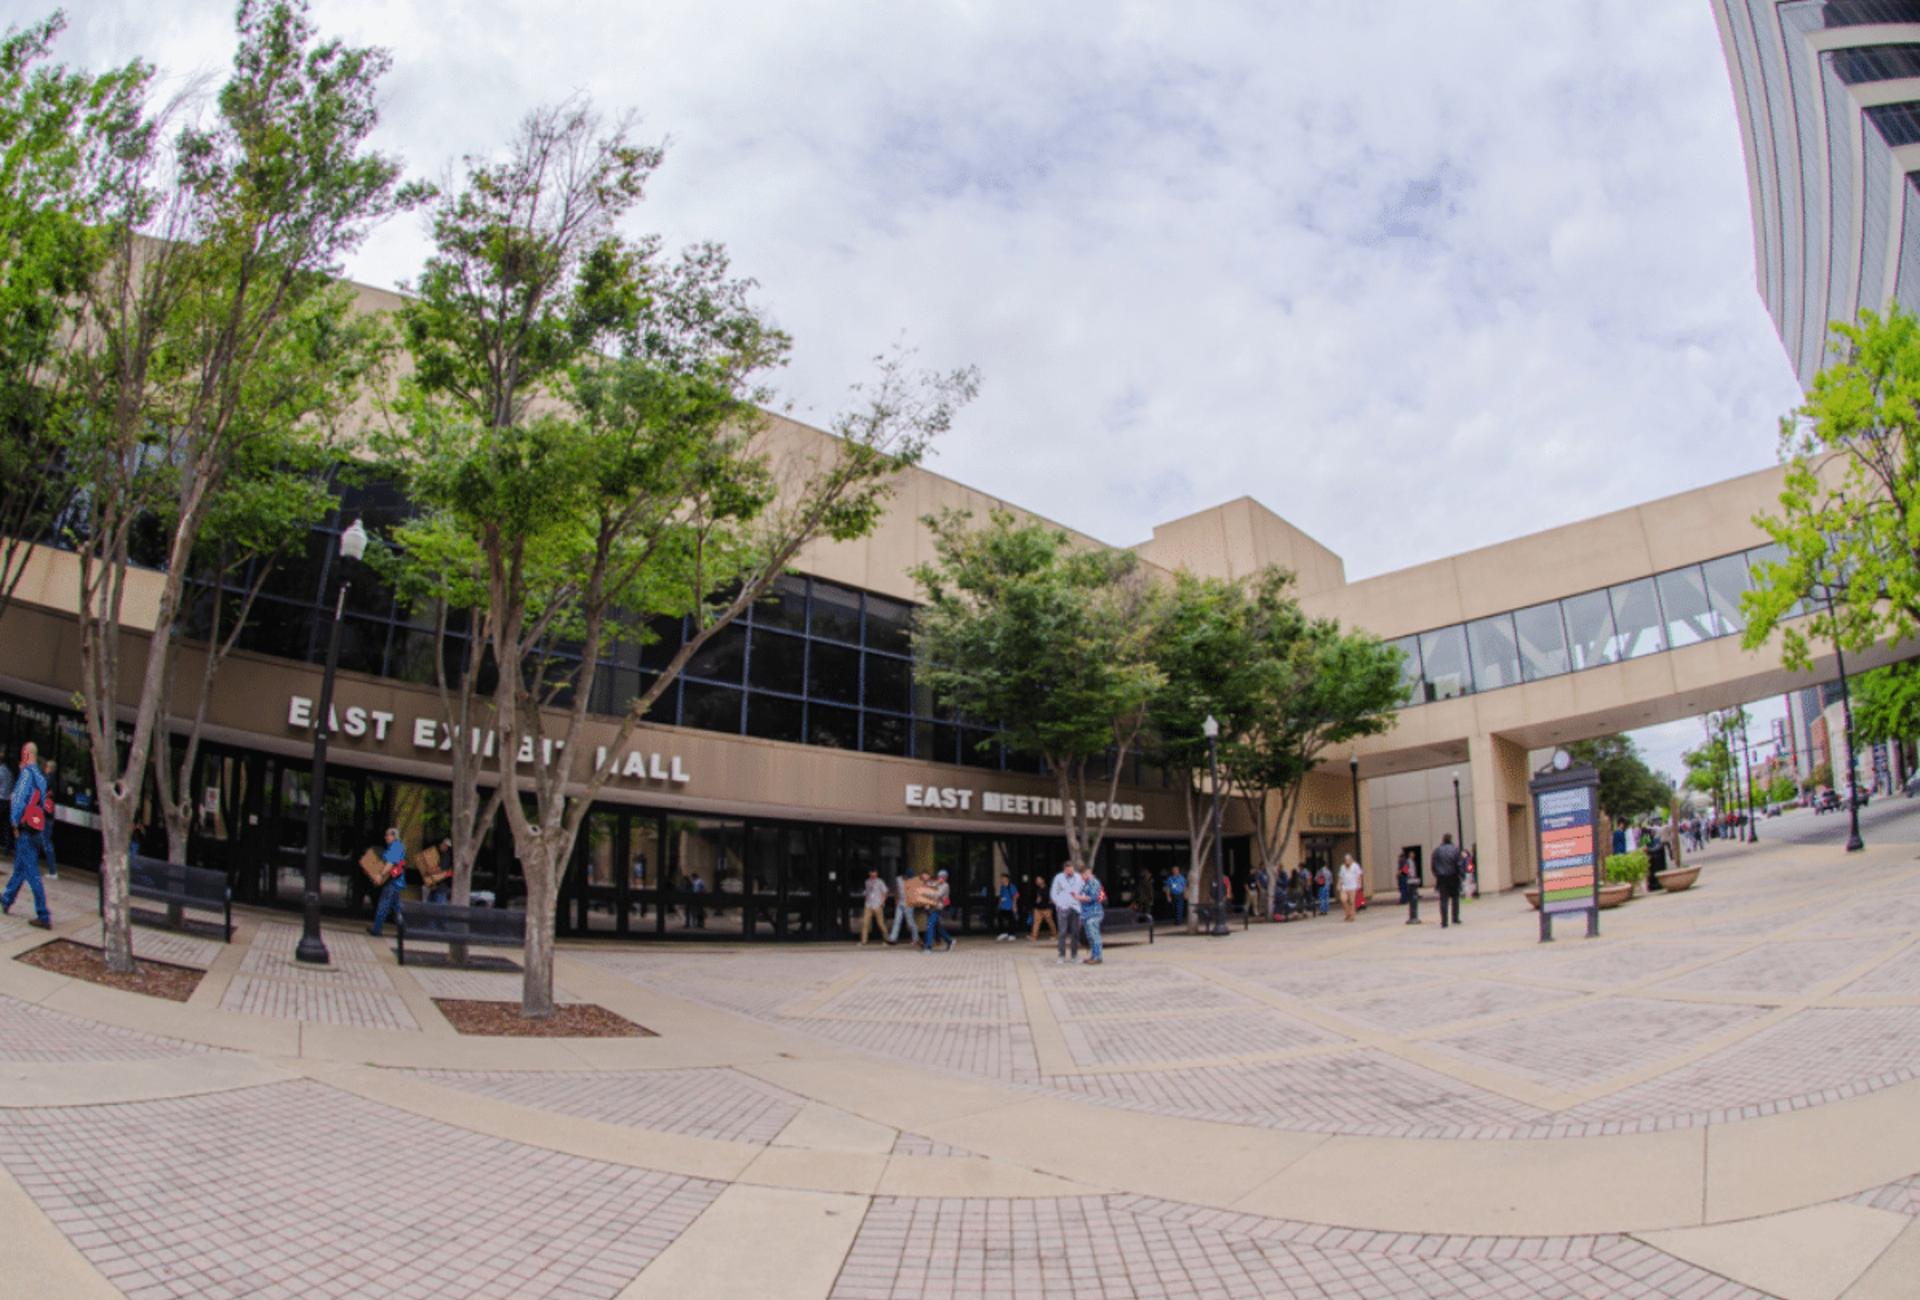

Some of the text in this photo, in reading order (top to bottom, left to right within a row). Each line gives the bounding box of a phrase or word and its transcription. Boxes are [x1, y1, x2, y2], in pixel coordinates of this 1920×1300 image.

[412, 717, 570, 768] EXHBI
[905, 784, 972, 810] EAST
[1085, 800, 1144, 821] ROOMS
